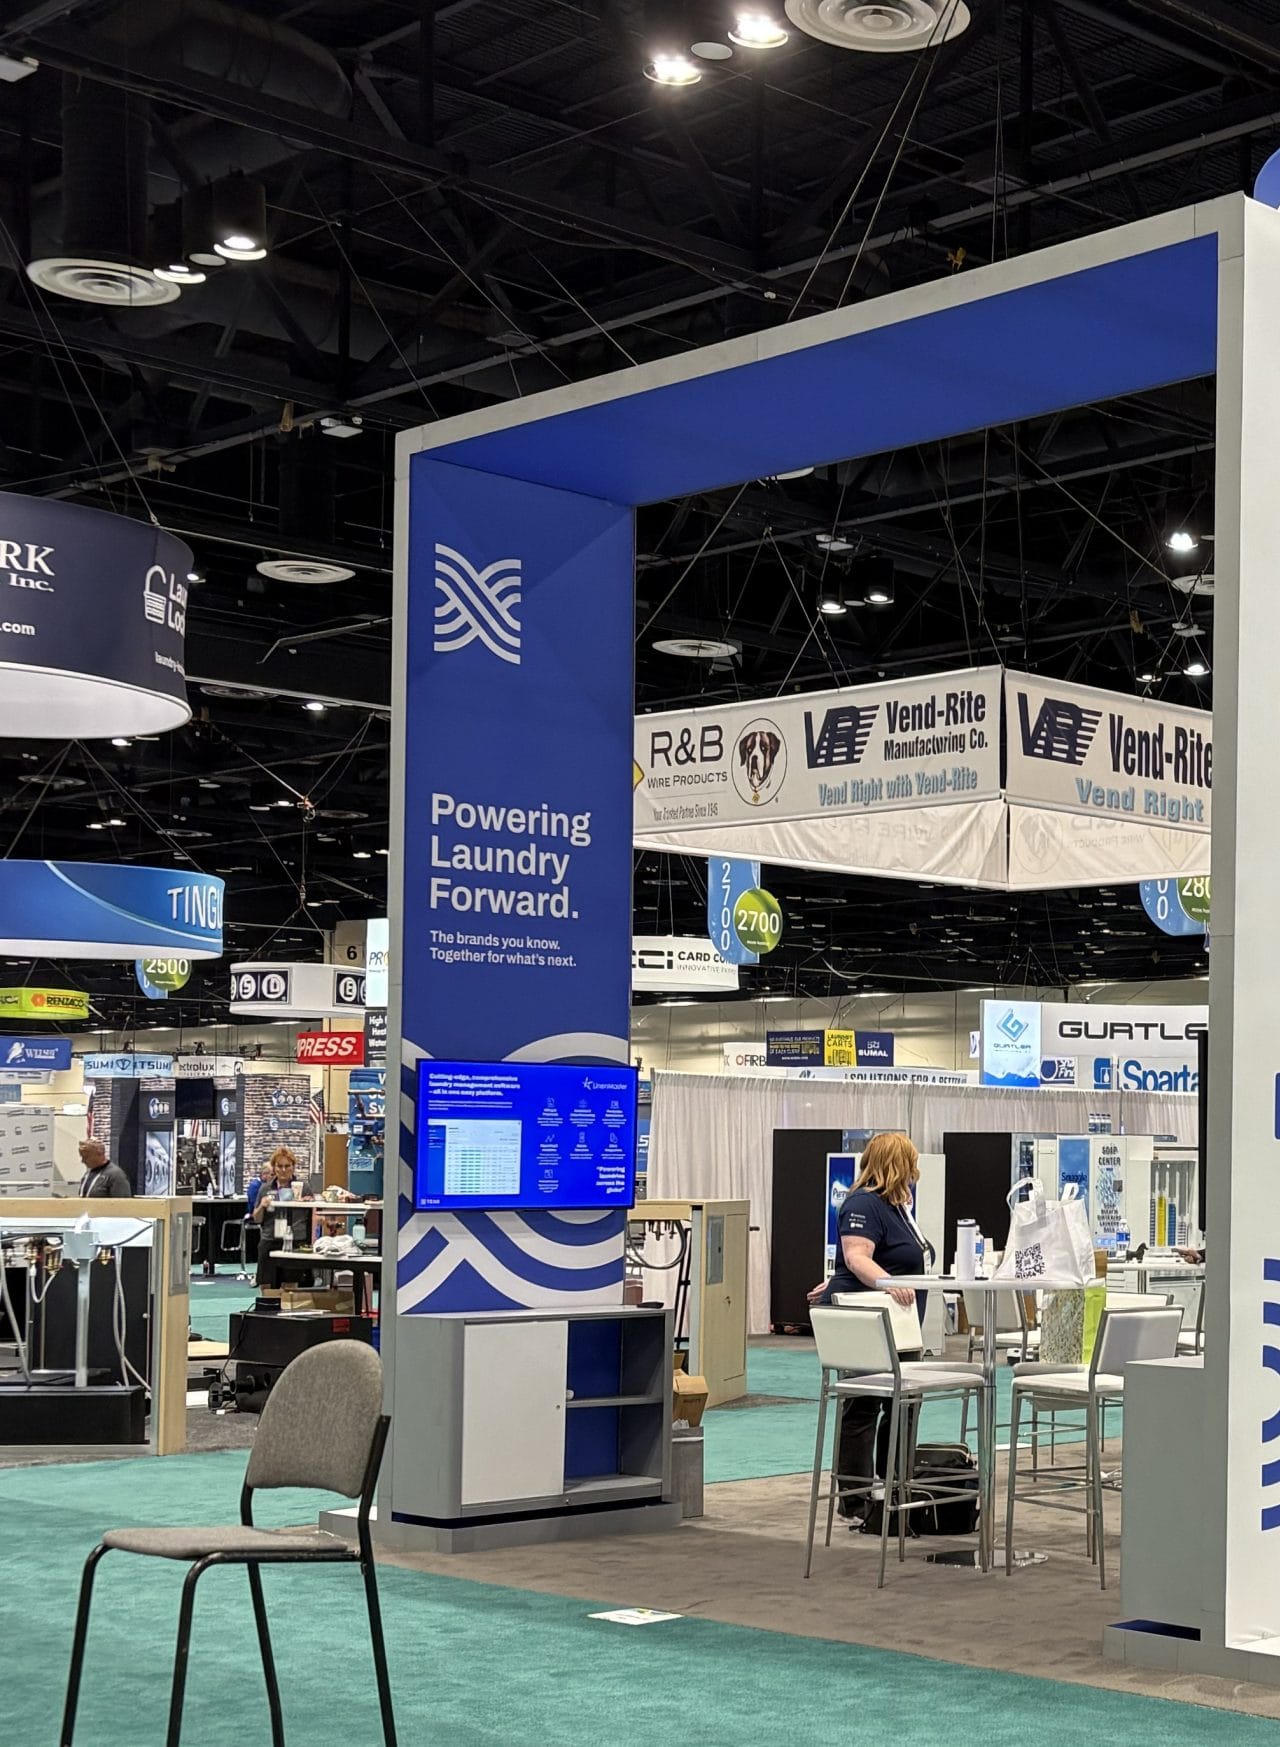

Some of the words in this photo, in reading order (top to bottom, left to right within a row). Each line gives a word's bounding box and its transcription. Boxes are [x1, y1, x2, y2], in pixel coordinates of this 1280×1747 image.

[9, 572, 55, 592] Inc.
[886, 690, 986, 734] Vend-Rite
[650, 724, 724, 768] R&B
[883, 732, 966, 761] Manufacturing
[969, 727, 988, 750] Co.
[1109, 712, 1212, 789] Vend-Rite
[647, 777, 671, 789] WIRE
[672, 771, 728, 786] PRODUCTS
[818, 782, 847, 807] Vend
[850, 779, 883, 806] Right
[886, 774, 913, 799] with
[915, 767, 978, 796] Vend-Rite
[1075, 777, 1135, 813] Vend
[1143, 795, 1204, 823] Right
[432, 793, 592, 847] Powering
[431, 835, 570, 885] Laundry
[430, 877, 579, 918] Forward.
[737, 909, 779, 934] 2700
[430, 930, 454, 943] The
[456, 932, 500, 946] brands
[502, 937, 524, 949] you
[526, 936, 560, 950] know.
[347, 946, 358, 960] 6
[430, 947, 484, 963] Together
[487, 952, 503, 963] for
[506, 952, 545, 966] what's
[547, 956, 577, 967] next.
[678, 951, 711, 962] CARD
[146, 957, 189, 976] 2500
[827, 1040, 853, 1048] CARTS
[592, 1082, 627, 1090] LinenMaster
[1101, 1146, 1118, 1155] SOAP
[1098, 1156, 1121, 1166] CENTER
[1061, 1172, 1087, 1184] Snuggle
